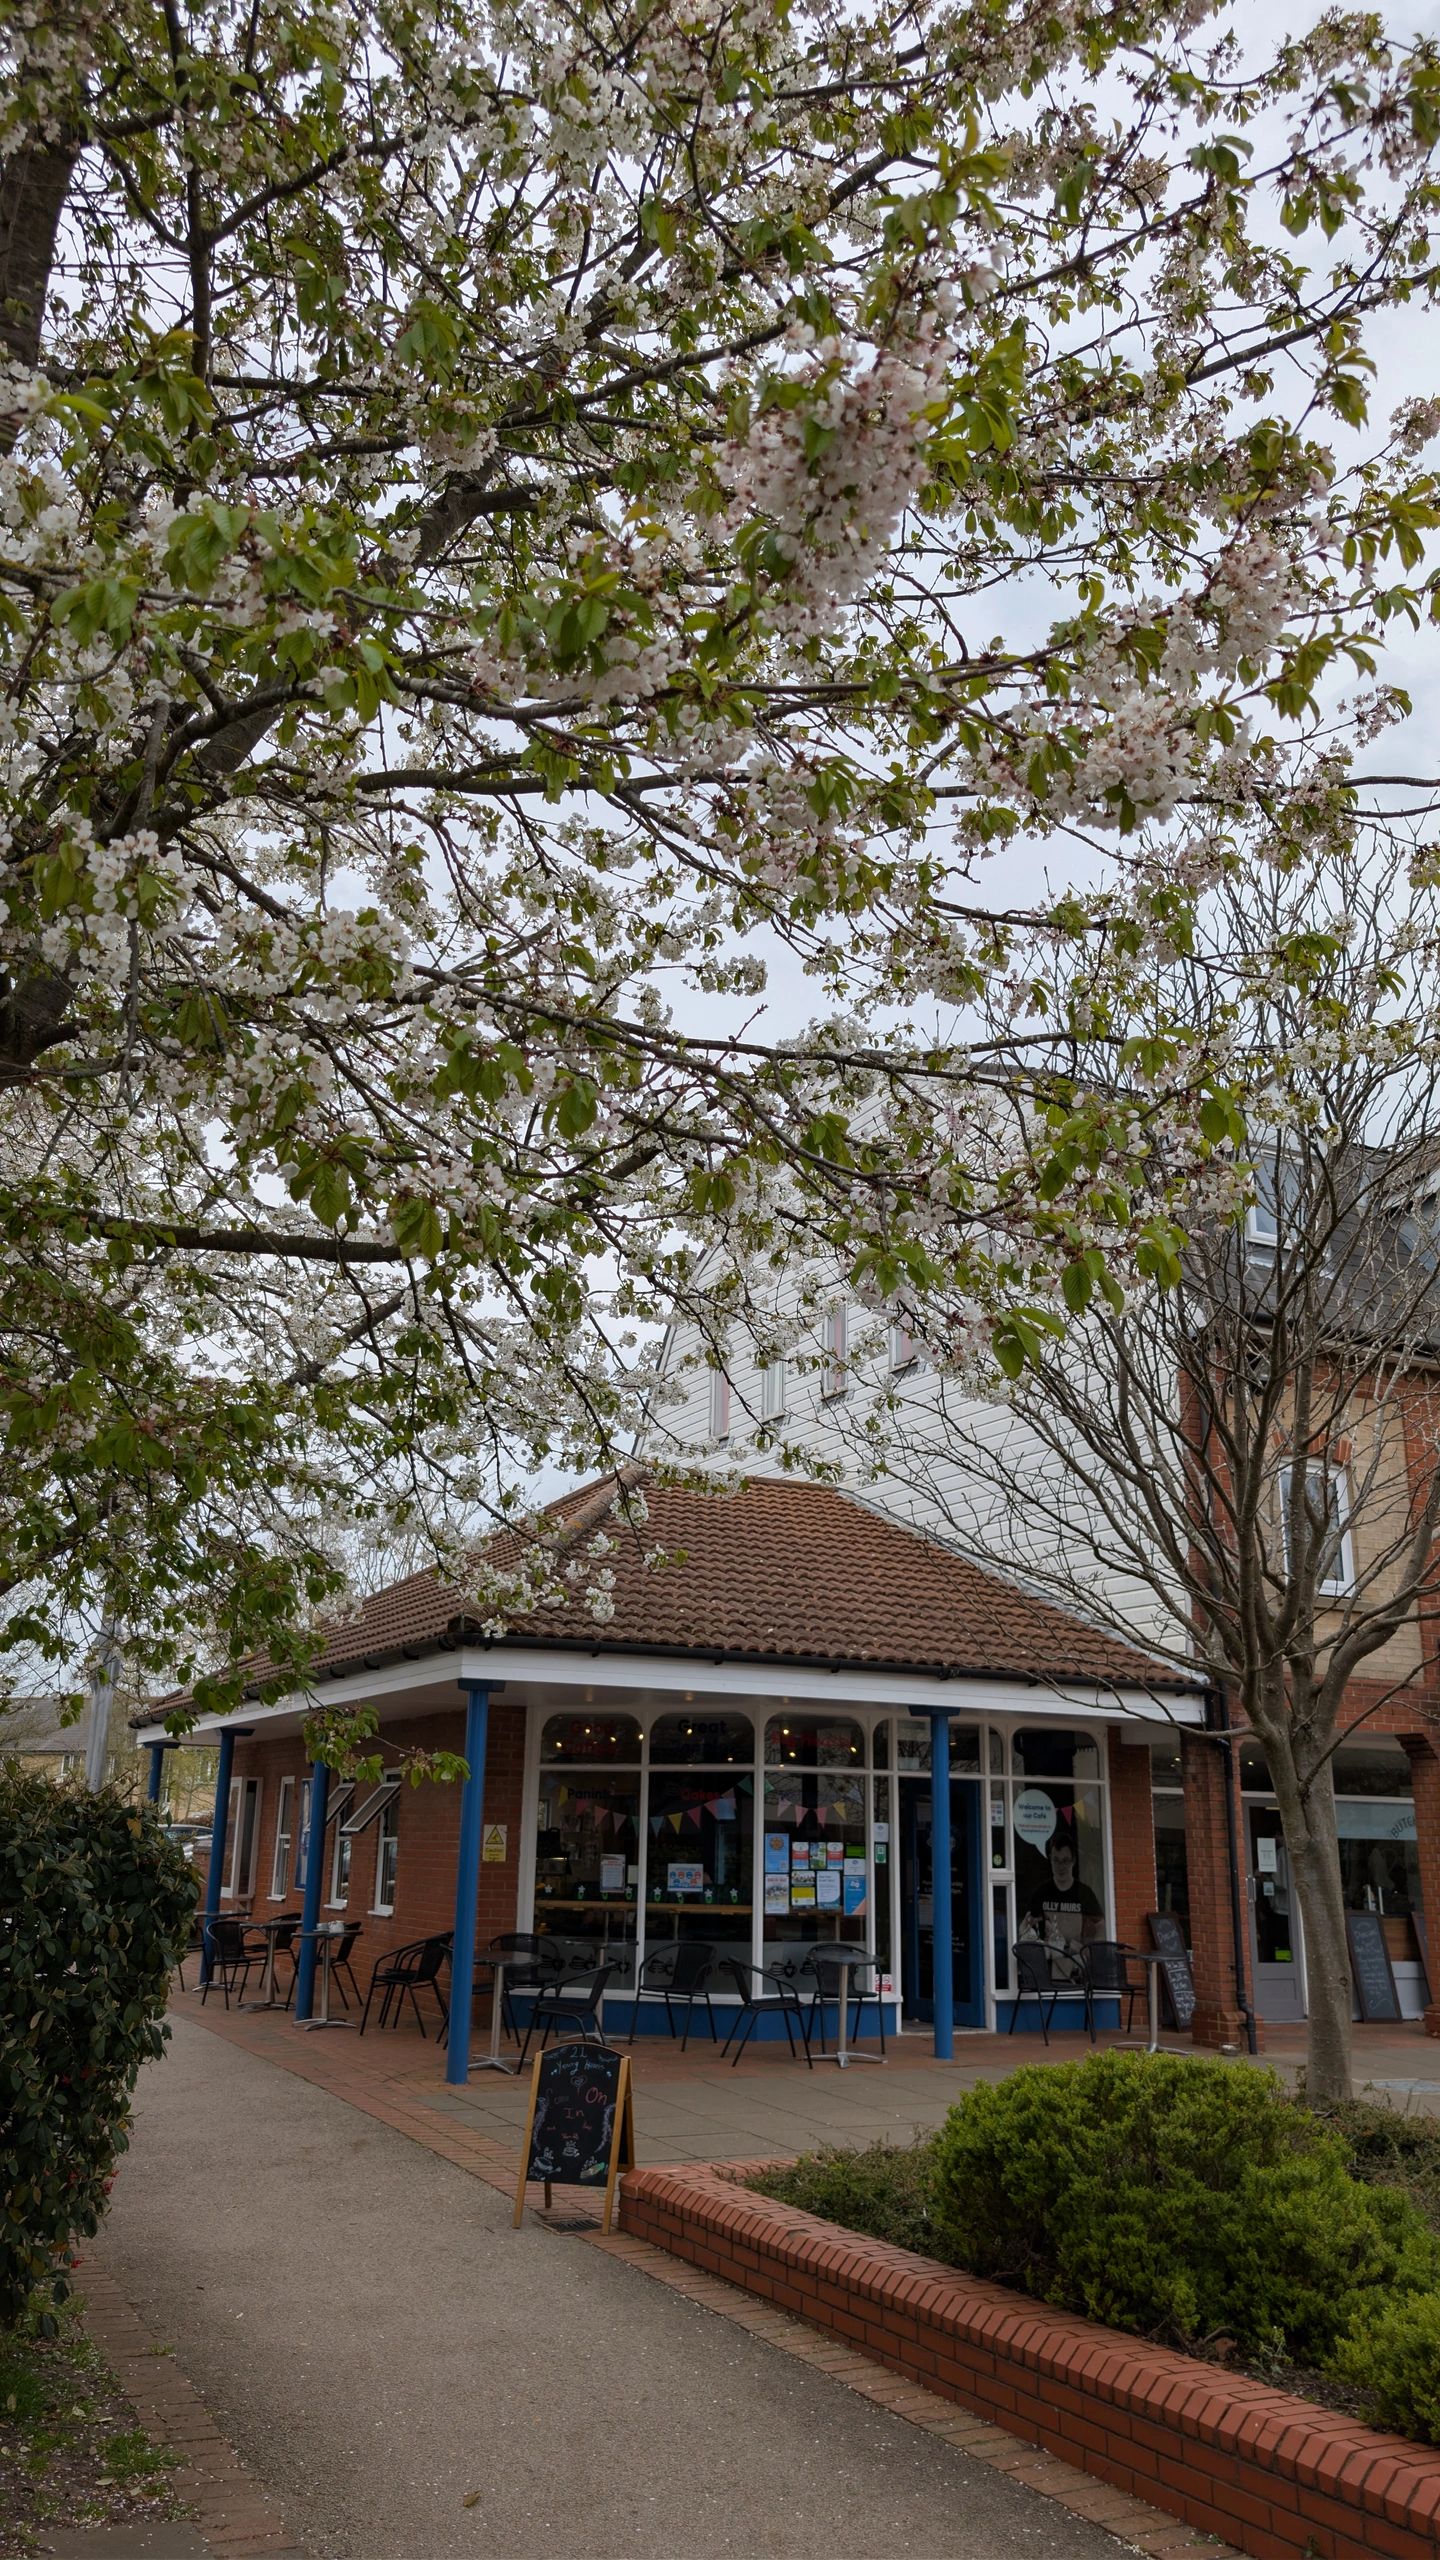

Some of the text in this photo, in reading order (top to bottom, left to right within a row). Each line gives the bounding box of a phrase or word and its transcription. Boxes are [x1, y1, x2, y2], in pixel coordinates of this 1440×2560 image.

[678, 1719, 728, 1735] Great
[1018, 1803, 1044, 1811] Welcome
[1042, 1901, 1082, 1913] OLLY MURS
[569, 2046, 588, 2058] 21
[556, 2060, 580, 2076] Young
[585, 2086, 608, 2106] On
[563, 2106, 585, 2120] In
